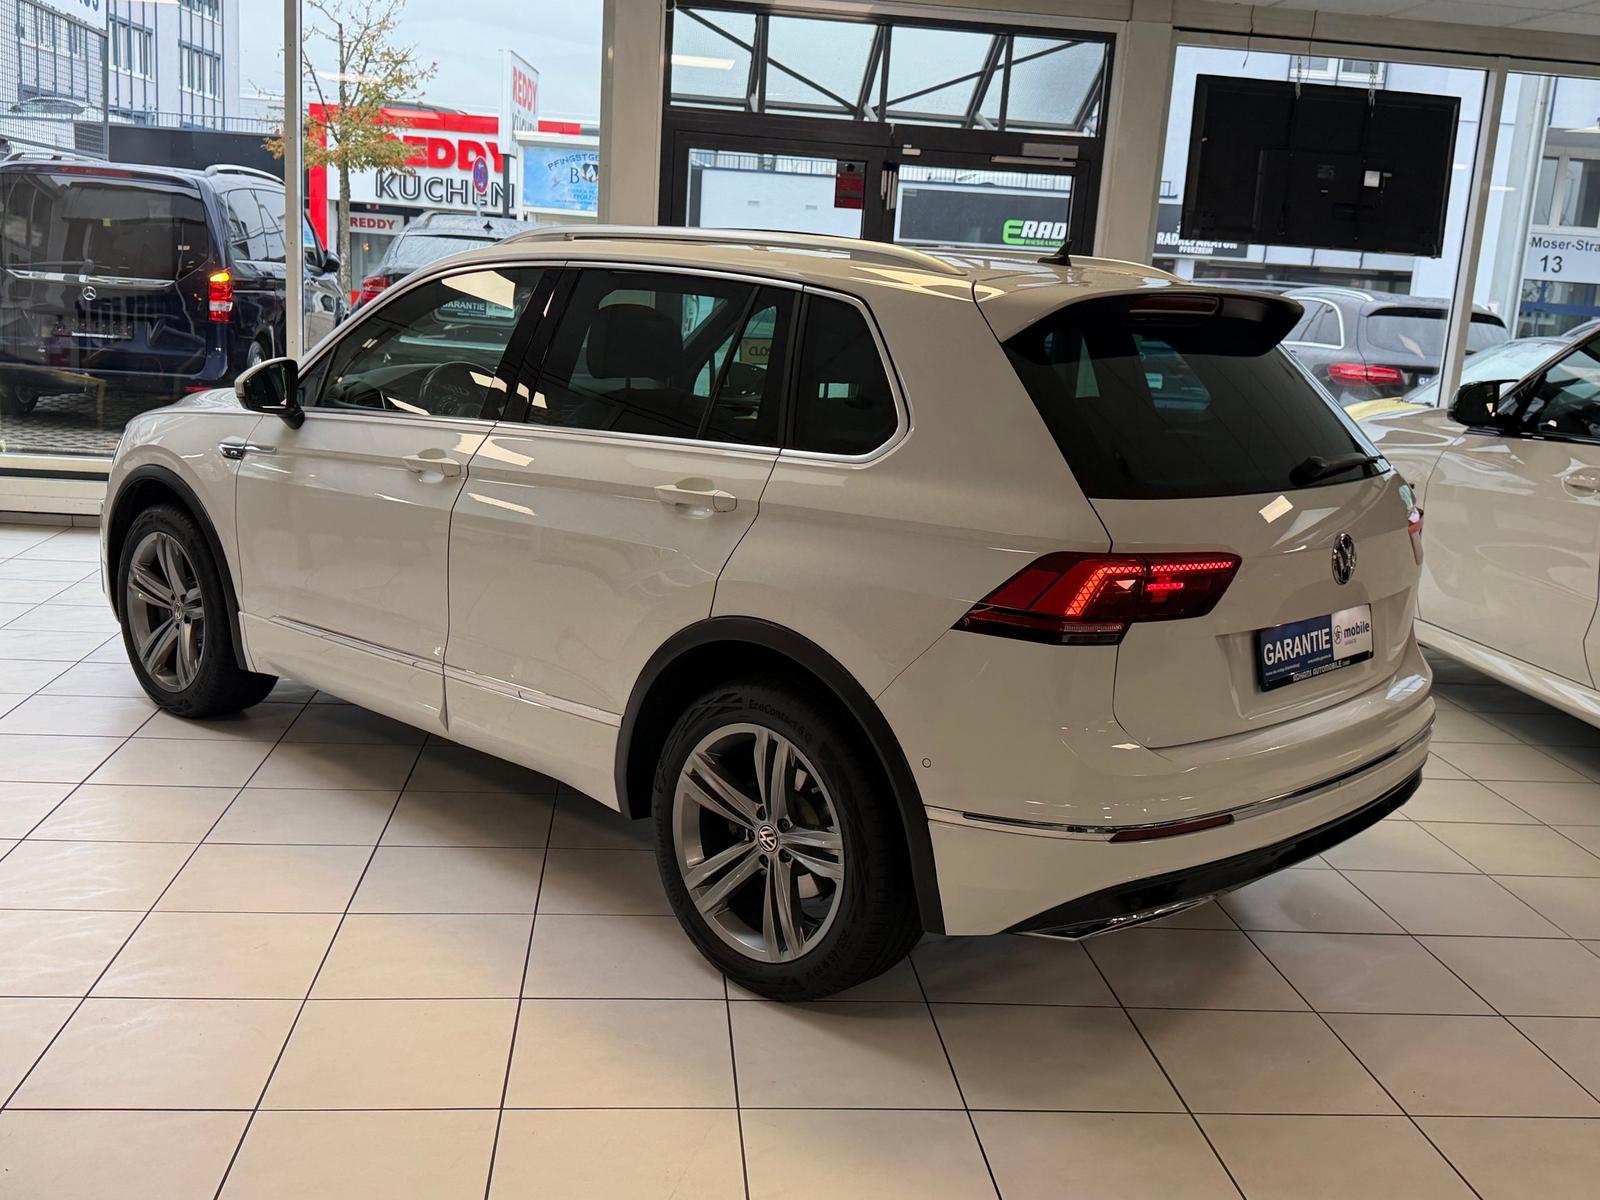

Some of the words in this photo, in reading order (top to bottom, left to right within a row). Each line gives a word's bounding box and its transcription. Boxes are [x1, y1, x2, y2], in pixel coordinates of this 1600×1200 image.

[512, 66, 537, 115] REDDY
[350, 217, 395, 230] REDDY
[1540, 255, 1563, 273] 13
[1344, 621, 1370, 638] mobile
[1264, 628, 1331, 666] GARANTIE
